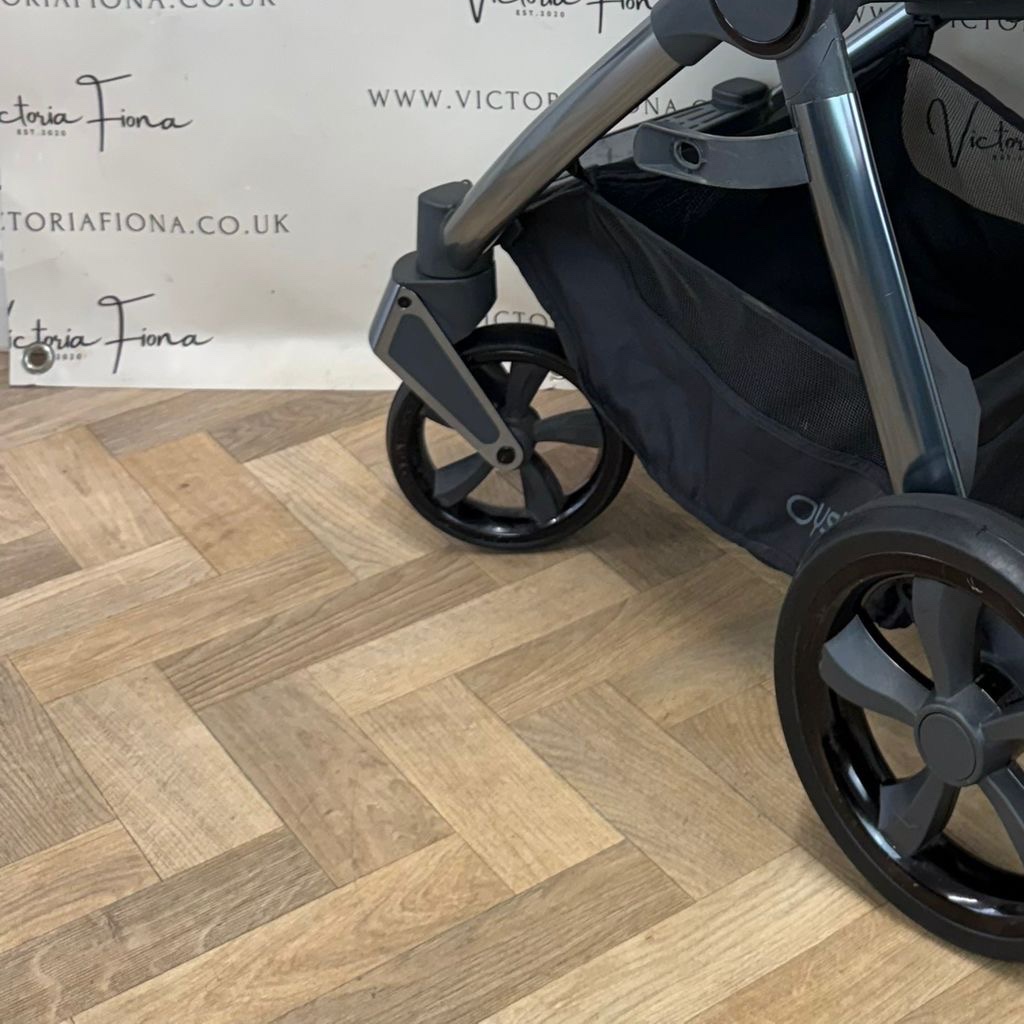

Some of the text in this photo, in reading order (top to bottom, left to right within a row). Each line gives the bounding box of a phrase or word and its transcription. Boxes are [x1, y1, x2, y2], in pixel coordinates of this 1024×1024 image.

[76, 73, 193, 152] Fiona
[0, 212, 290, 235] TORIAFIONA.CO.UK
[97, 293, 213, 374] Fiona
